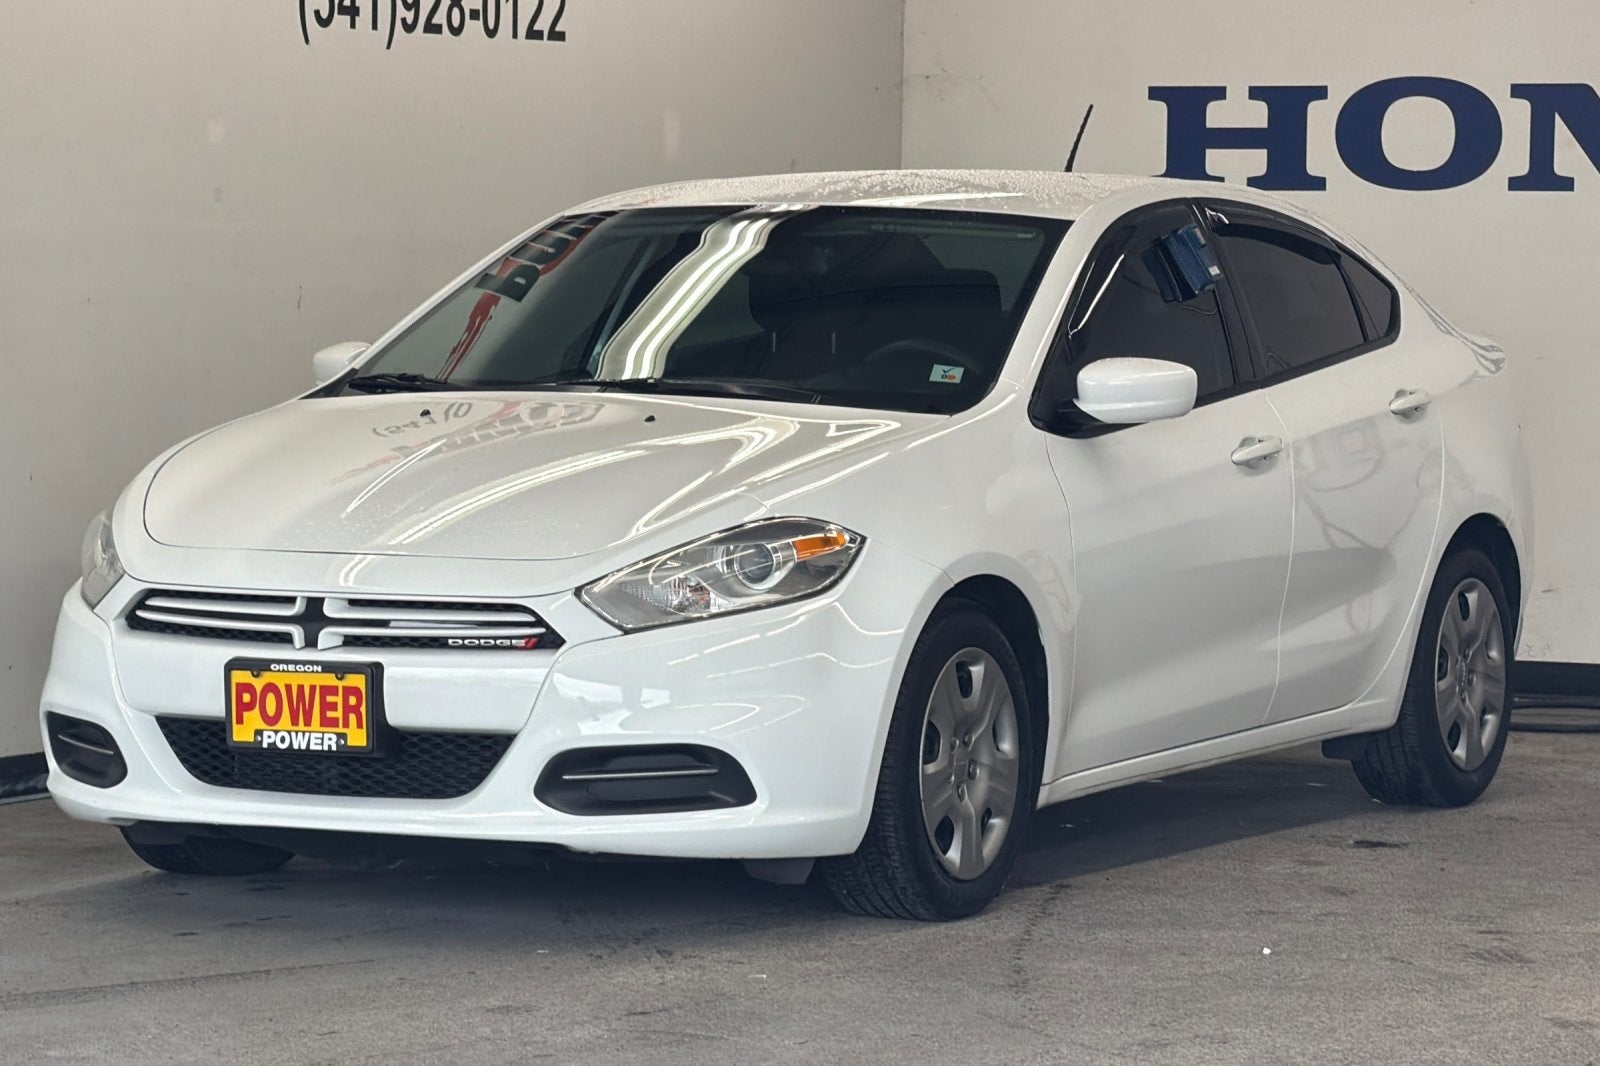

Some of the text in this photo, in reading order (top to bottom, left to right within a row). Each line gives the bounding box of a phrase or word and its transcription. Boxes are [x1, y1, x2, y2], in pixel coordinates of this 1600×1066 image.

[448, 638, 527, 647] DODGE
[270, 663, 322, 673] OREGON
[235, 682, 364, 730] POWER
[262, 731, 337, 751] POWER
